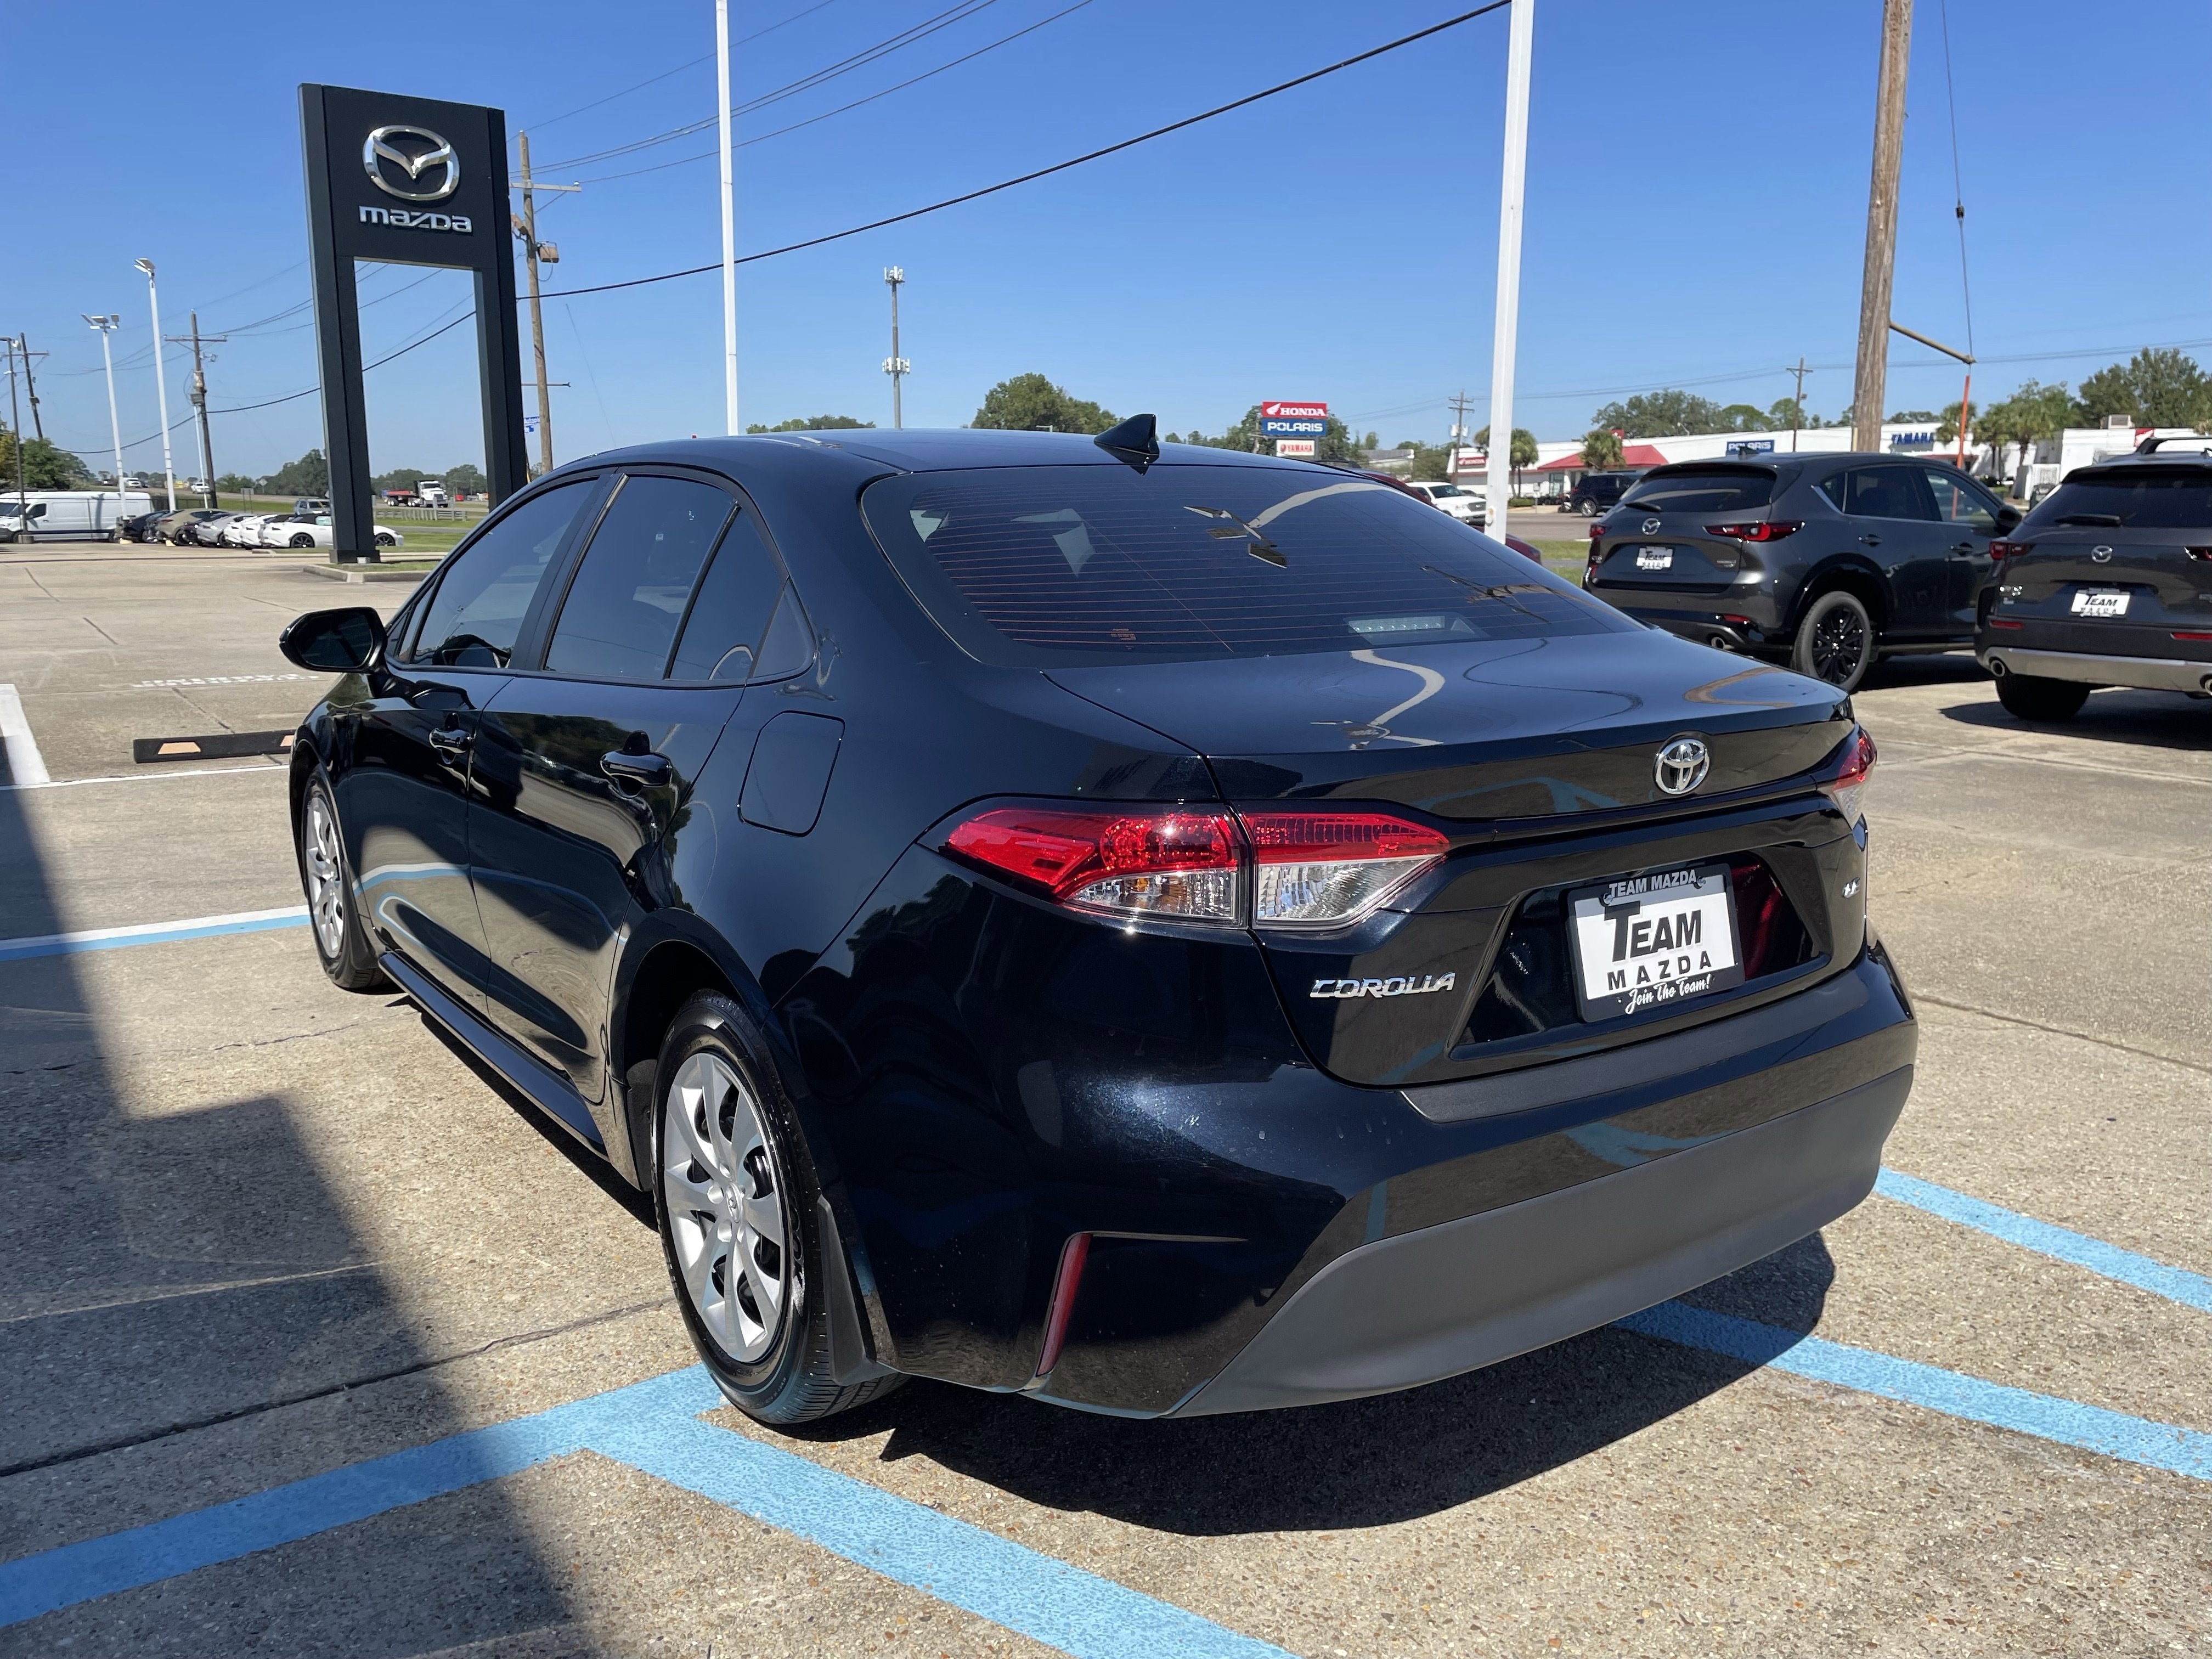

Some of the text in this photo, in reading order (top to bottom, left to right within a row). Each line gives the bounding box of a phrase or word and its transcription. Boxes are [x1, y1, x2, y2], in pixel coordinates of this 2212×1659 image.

[1280, 408, 1326, 416] HONDA
[1267, 422, 1323, 432] POLARIS
[1729, 442, 1771, 451] POARIS
[1609, 869, 1697, 898] TEAM MAZDA
[1604, 900, 1702, 962] TEAM
[1607, 951, 1712, 990] MAZDA
[1310, 972, 1456, 998] COROLLA
[1625, 974, 1711, 1014] Join The Team!
